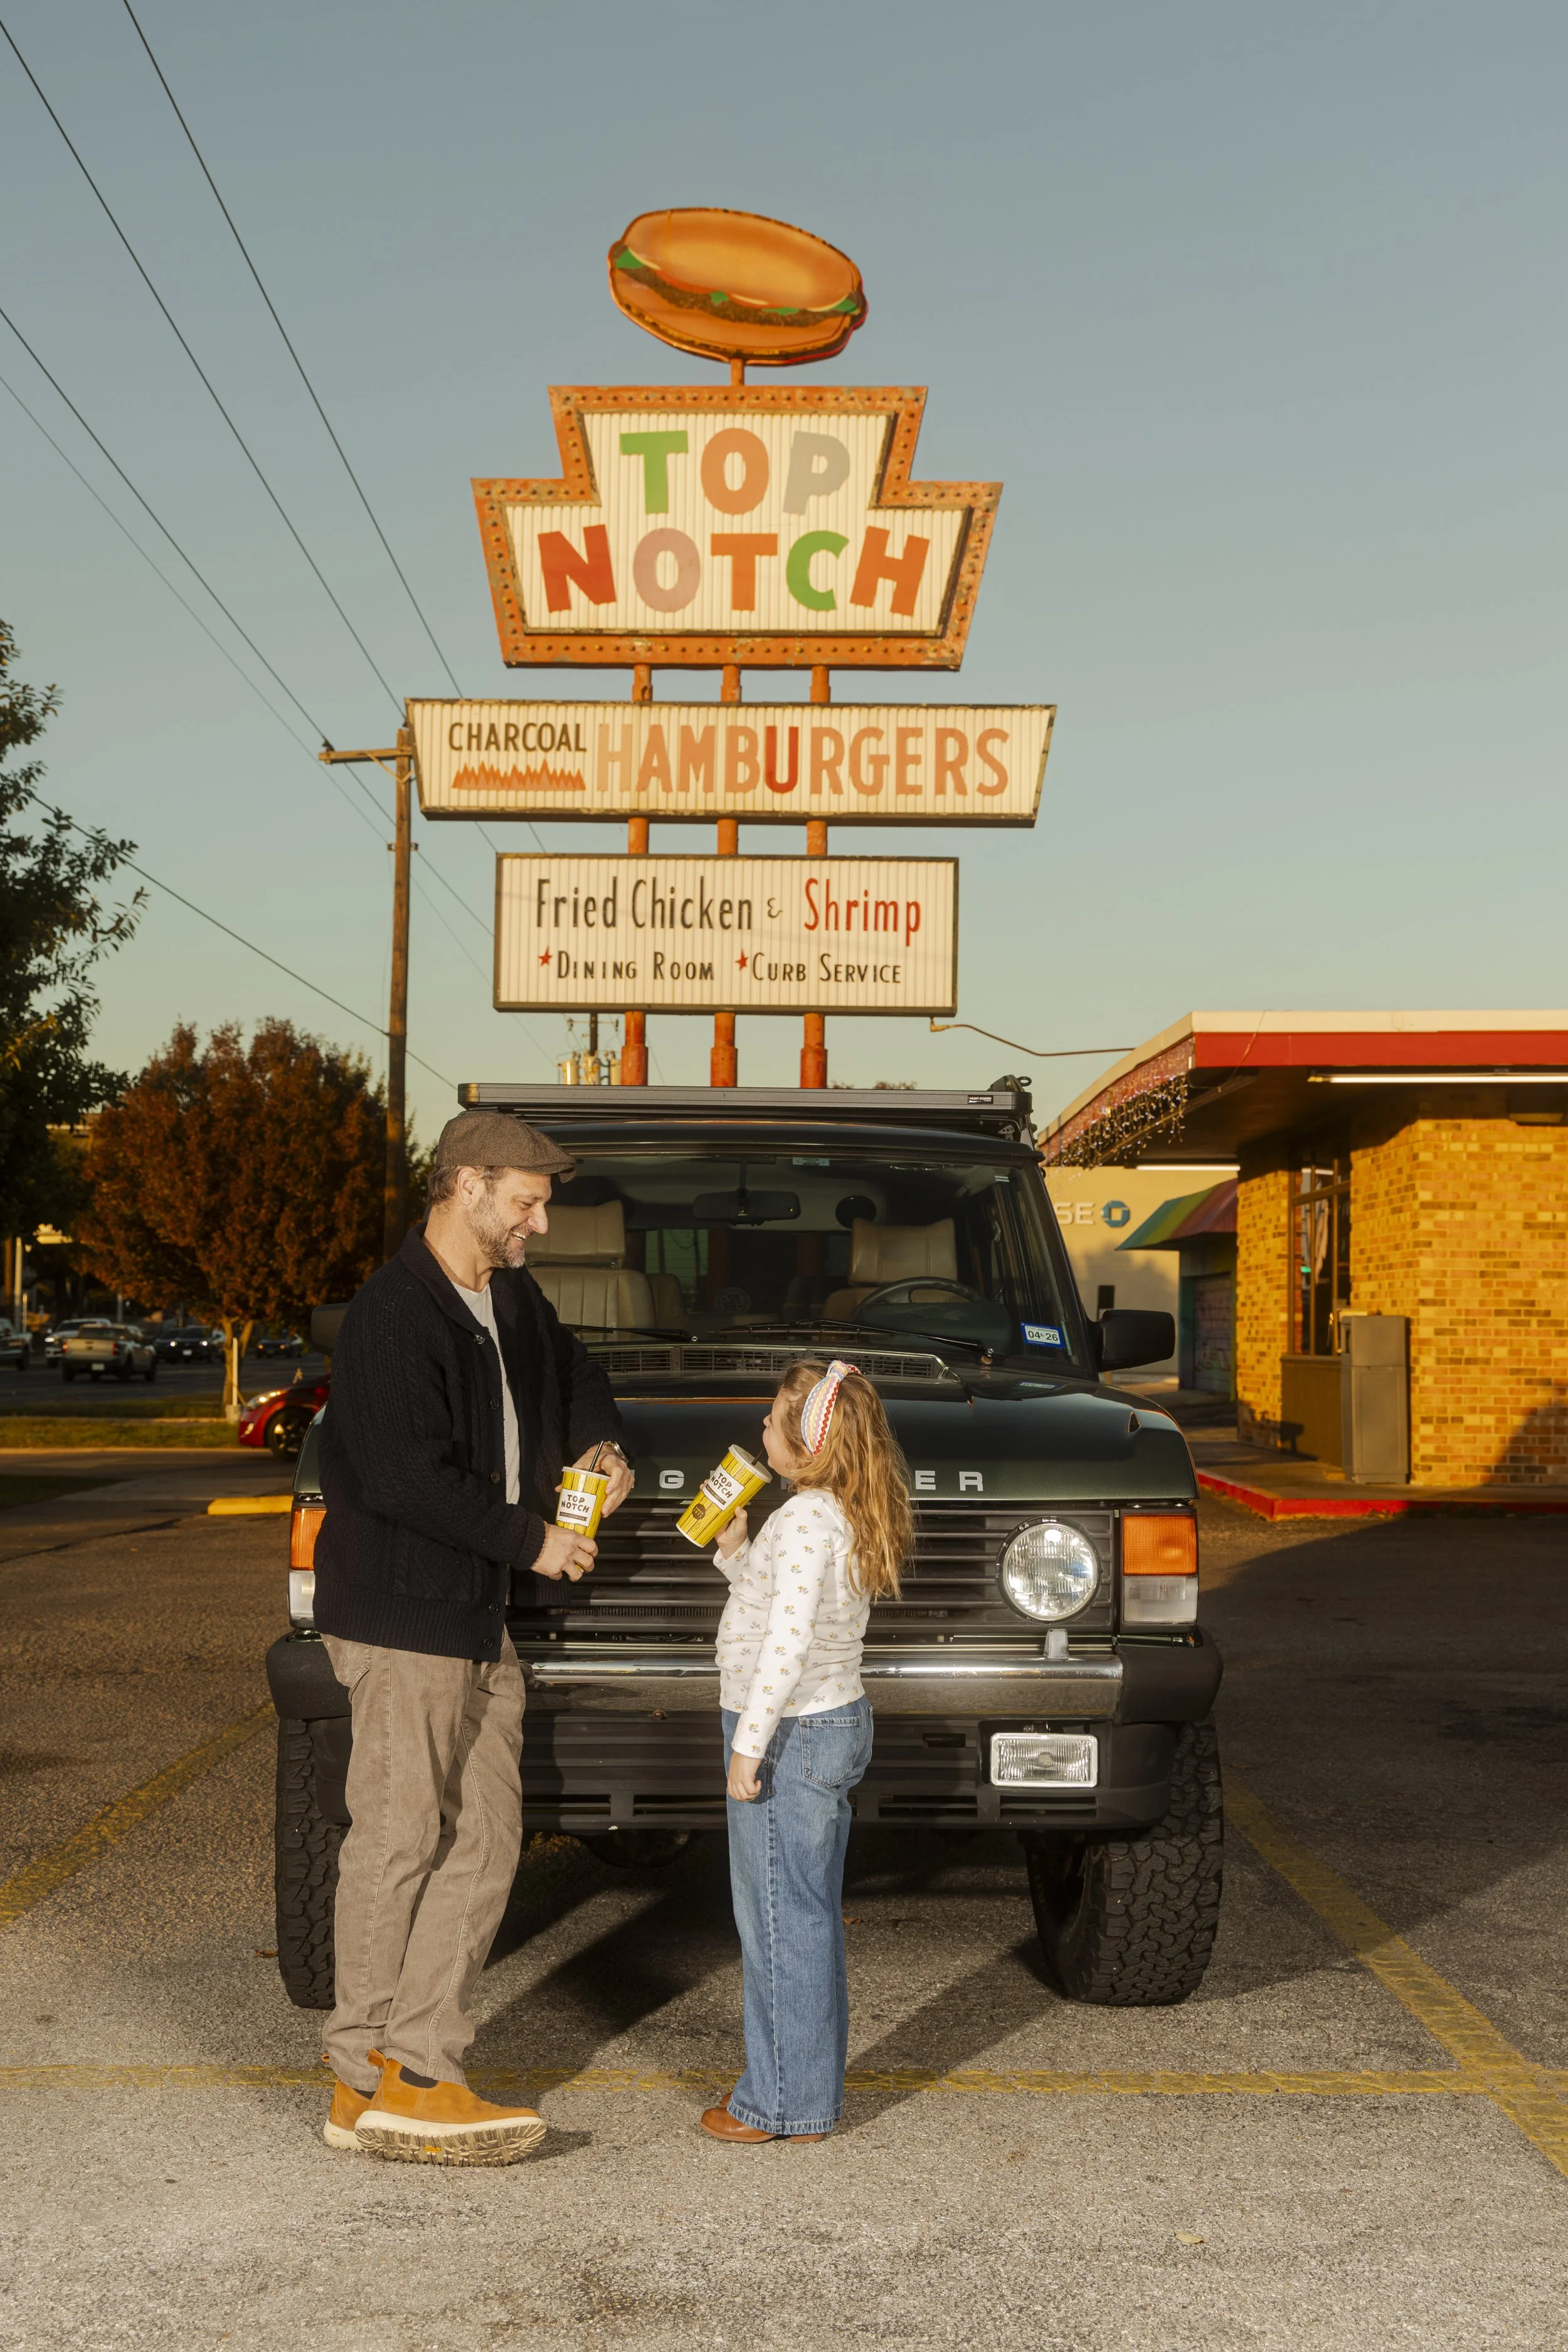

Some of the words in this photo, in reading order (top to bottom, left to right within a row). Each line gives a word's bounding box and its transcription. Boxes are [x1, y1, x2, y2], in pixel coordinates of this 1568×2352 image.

[620, 428, 850, 516] TOP
[537, 524, 930, 617] NOTCH
[449, 721, 587, 753] CHARCOAL
[597, 723, 1010, 797] HAMBURGERS
[536, 876, 618, 929] Fried
[631, 876, 753, 930] Chicken
[766, 897, 783, 919] &
[803, 877, 921, 947] Shrimp
[557, 950, 637, 980] DINING
[653, 951, 714, 981] ROOM
[752, 953, 807, 982] CURB
[819, 953, 901, 983] SERVICE
[1053, 1202, 1096, 1226] SE
[1028, 1330, 1041, 1339] 04
[1046, 1333, 1059, 1342] 26
[710, 1475, 733, 1498] NOTCH
[718, 1473, 732, 1487] TOP
[561, 1501, 590, 1513] NOTCH
[567, 1495, 585, 1503] TOP
